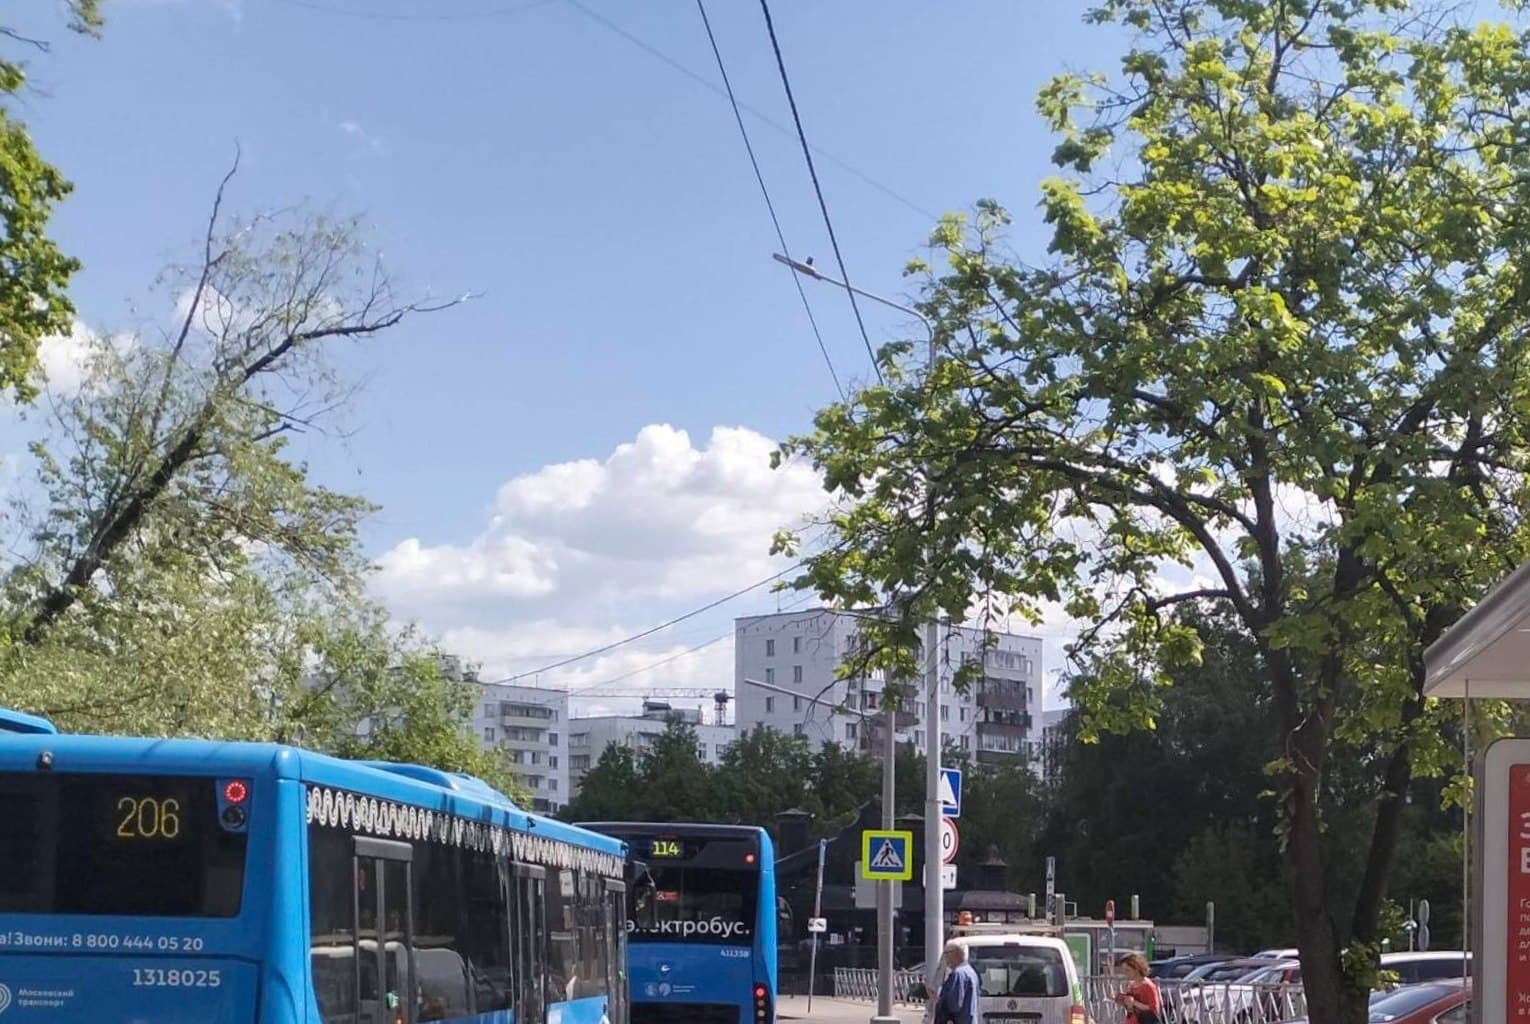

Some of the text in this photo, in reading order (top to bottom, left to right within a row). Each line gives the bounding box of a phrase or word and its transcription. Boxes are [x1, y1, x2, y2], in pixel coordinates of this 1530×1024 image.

[117, 797, 179, 838] 206
[652, 841, 680, 855] 114
[626, 917, 750, 938] эектробус.
[14, 932, 68, 947] Звони:
[72, 934, 82, 947] 8
[87, 934, 119, 948] 800
[123, 936, 153, 949] 444
[157, 937, 178, 950] 05
[183, 938, 203, 950] 20
[133, 968, 221, 987] 1318025
